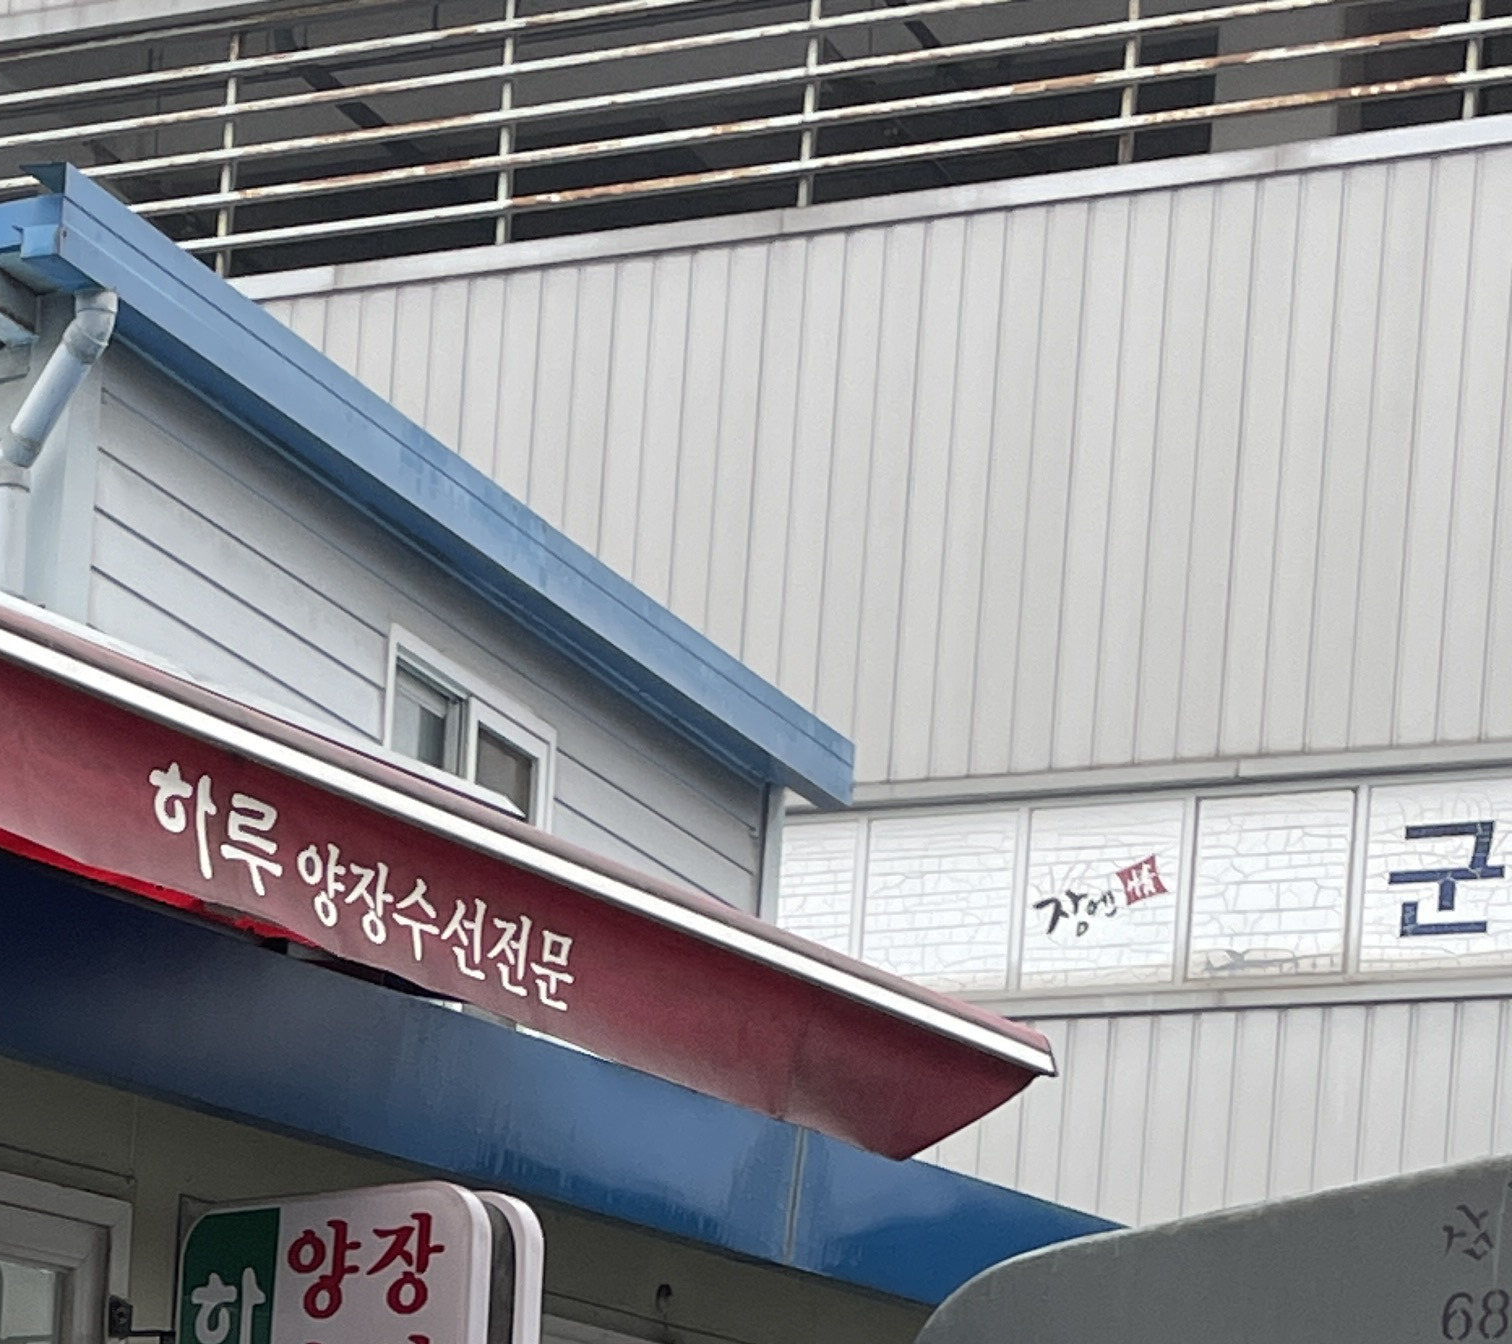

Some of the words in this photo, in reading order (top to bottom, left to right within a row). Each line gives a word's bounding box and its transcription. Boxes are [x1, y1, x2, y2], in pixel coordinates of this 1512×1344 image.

[149, 762, 282, 896] 하루
[297, 844, 574, 1010] 양장수선전문
[1389, 820, 1504, 937] 군
[287, 1212, 445, 1320] 양장
